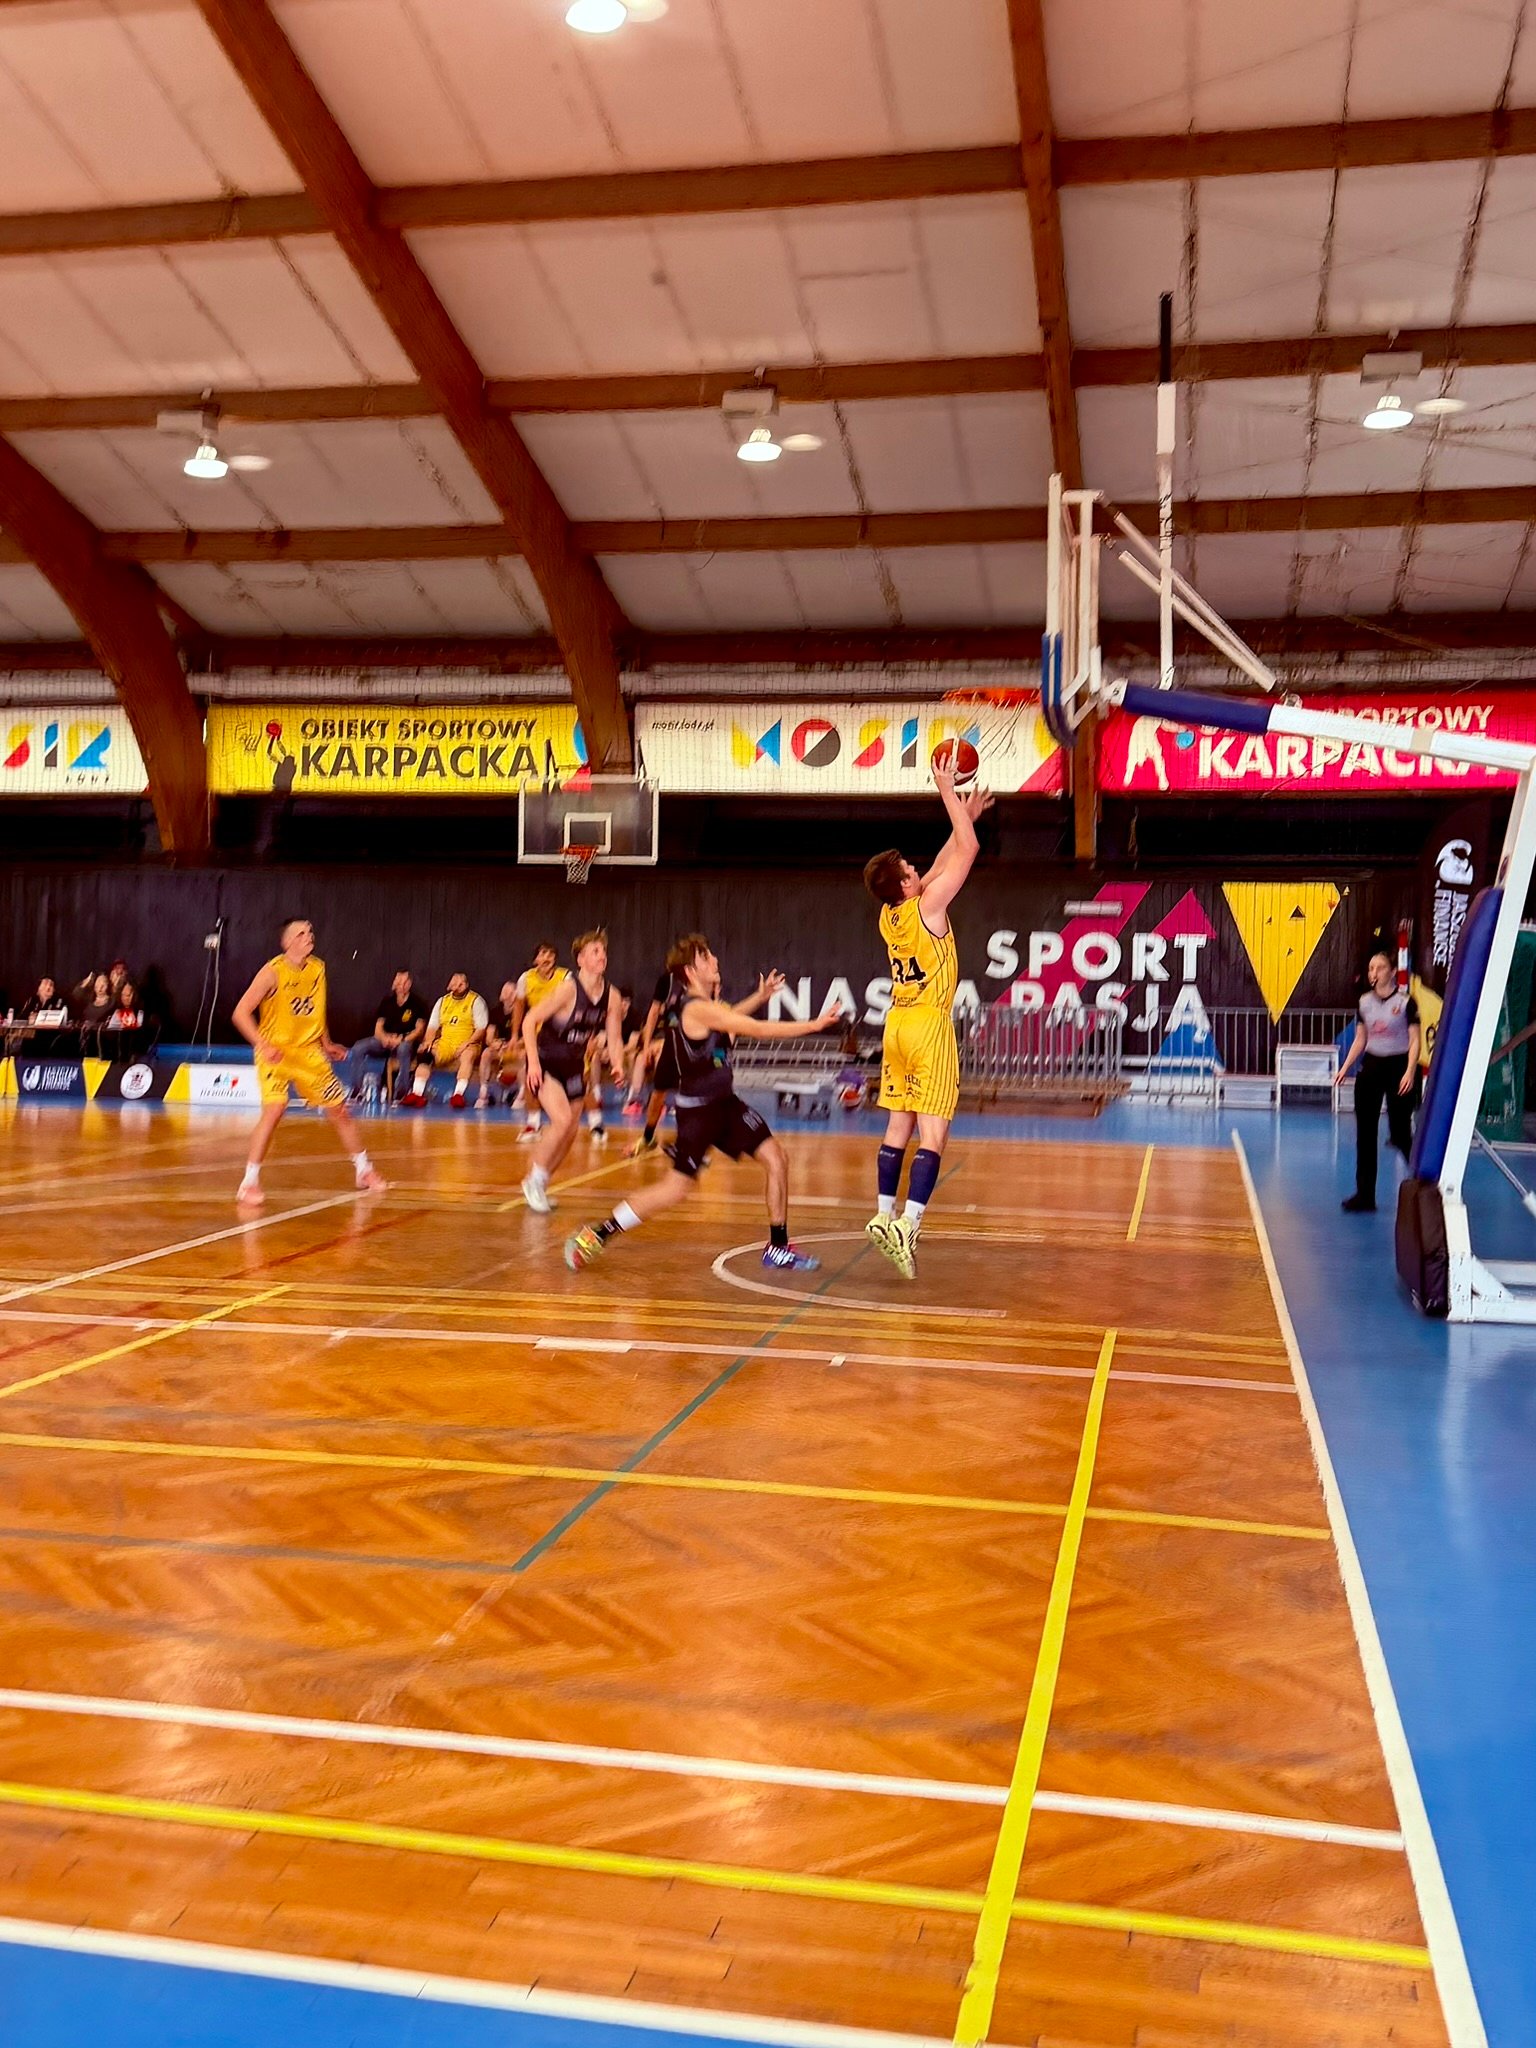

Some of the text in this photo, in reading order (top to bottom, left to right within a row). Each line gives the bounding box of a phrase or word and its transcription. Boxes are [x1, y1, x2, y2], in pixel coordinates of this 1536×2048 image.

[301, 718, 538, 741] OBIEKT SPORTOWY
[1324, 705, 1494, 731] ORTOWY
[301, 743, 540, 779] KARPACKA
[1199, 733, 1500, 778] KARPAC
[892, 956, 927, 985] 34
[985, 930, 1208, 981] SPORT
[767, 976, 1214, 1040] NASA PASJA
